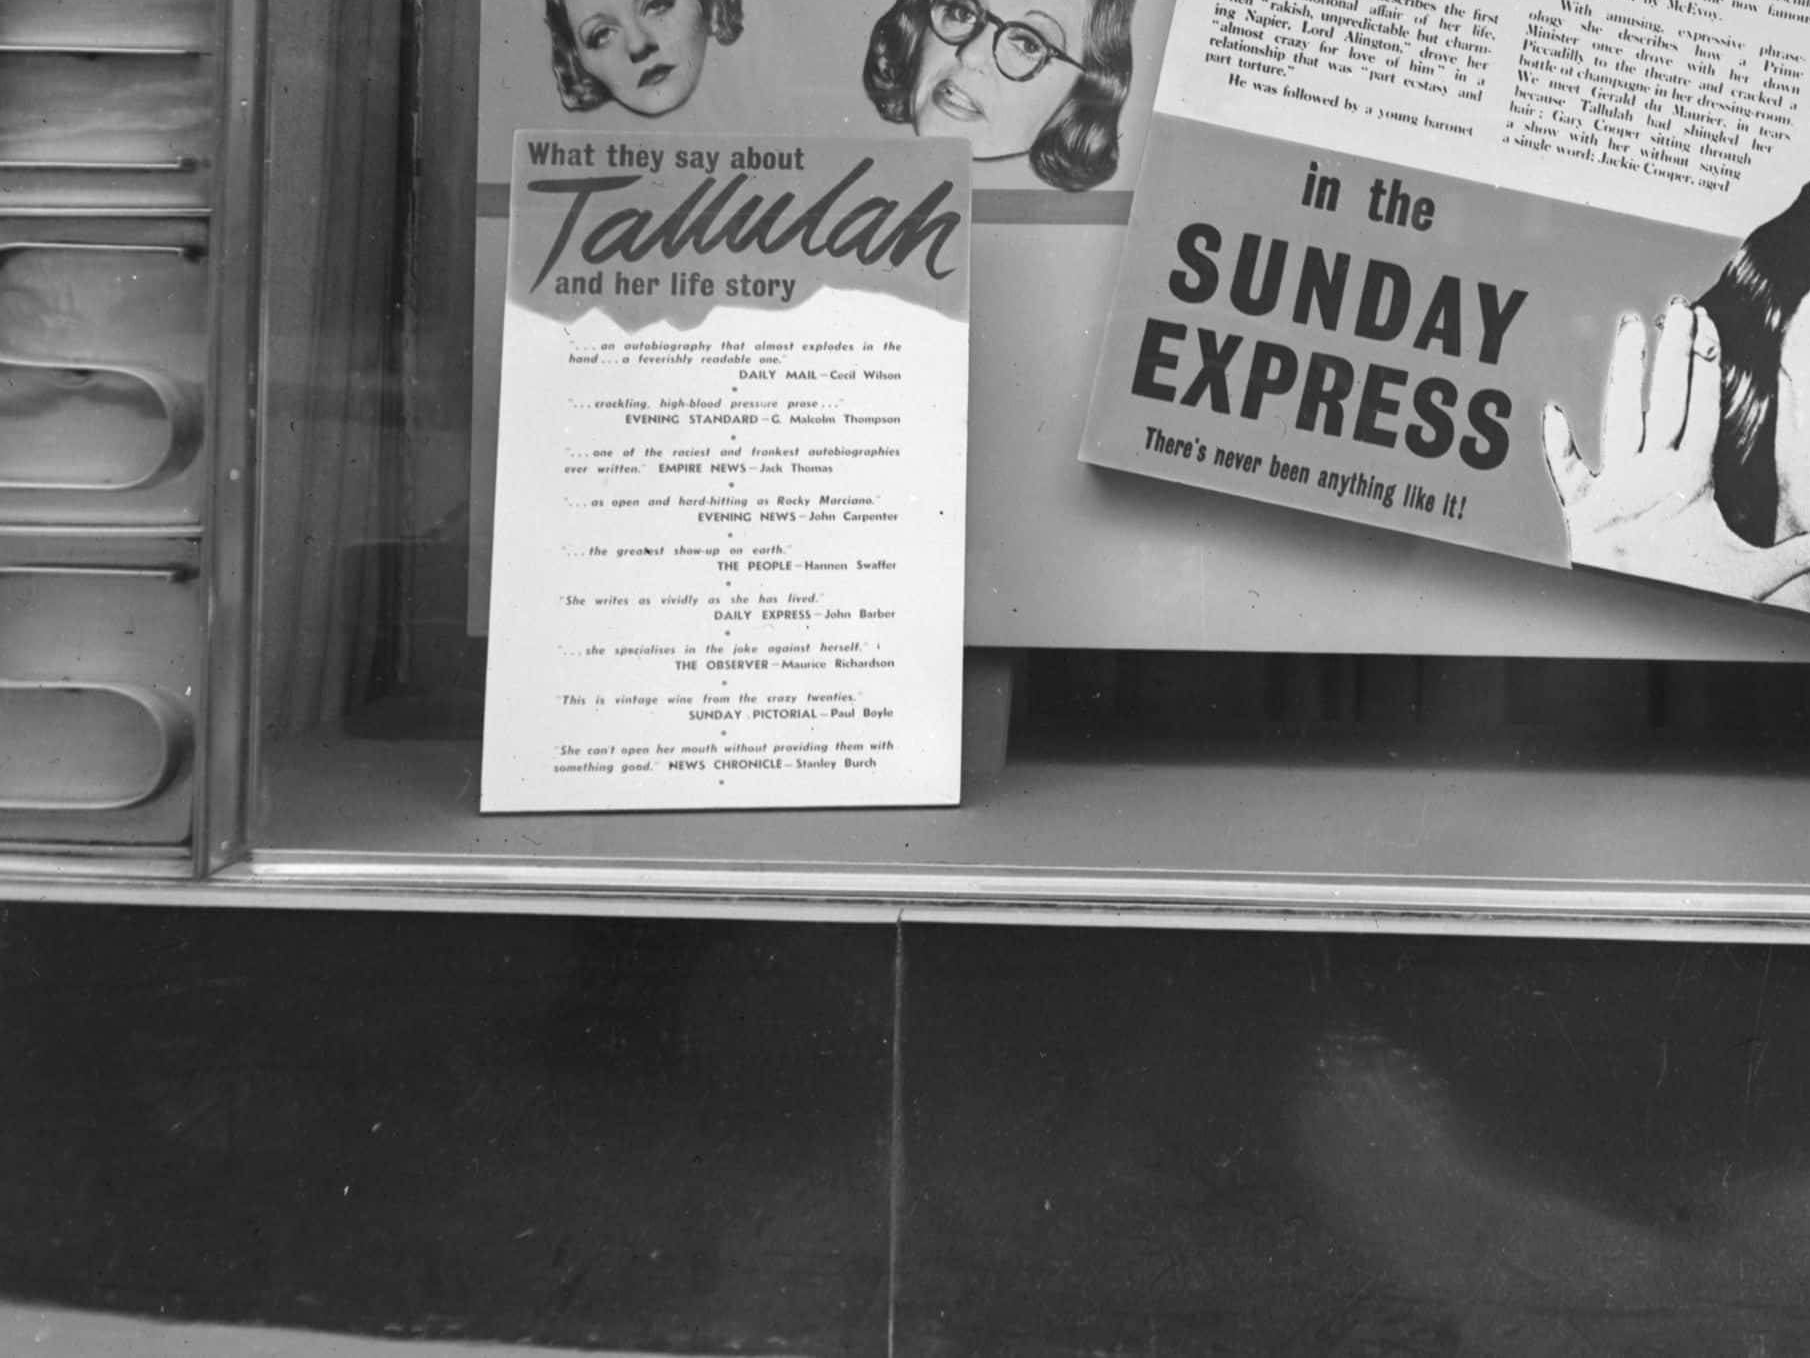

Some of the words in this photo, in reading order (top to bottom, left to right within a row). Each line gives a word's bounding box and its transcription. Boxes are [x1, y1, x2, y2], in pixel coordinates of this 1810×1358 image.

[528, 141, 594, 166] What
[606, 143, 663, 173] they
[675, 149, 719, 174] say
[730, 146, 804, 170] about
[1301, 161, 1341, 212] in
[1368, 178, 1436, 231] the
[527, 157, 961, 294] Tallulah
[554, 270, 602, 294] and
[615, 271, 659, 295] her
[671, 271, 713, 296] life
[725, 274, 795, 302] story
[1168, 222, 1529, 366] SUNDAY
[1130, 317, 1513, 471] EXPRESS
[1145, 426, 1206, 462] There's
[1213, 447, 1262, 473] never
[1268, 454, 1309, 483] been
[1317, 470, 1396, 507] anything
[1403, 483, 1435, 512] like
[1442, 492, 1466, 519] it!
